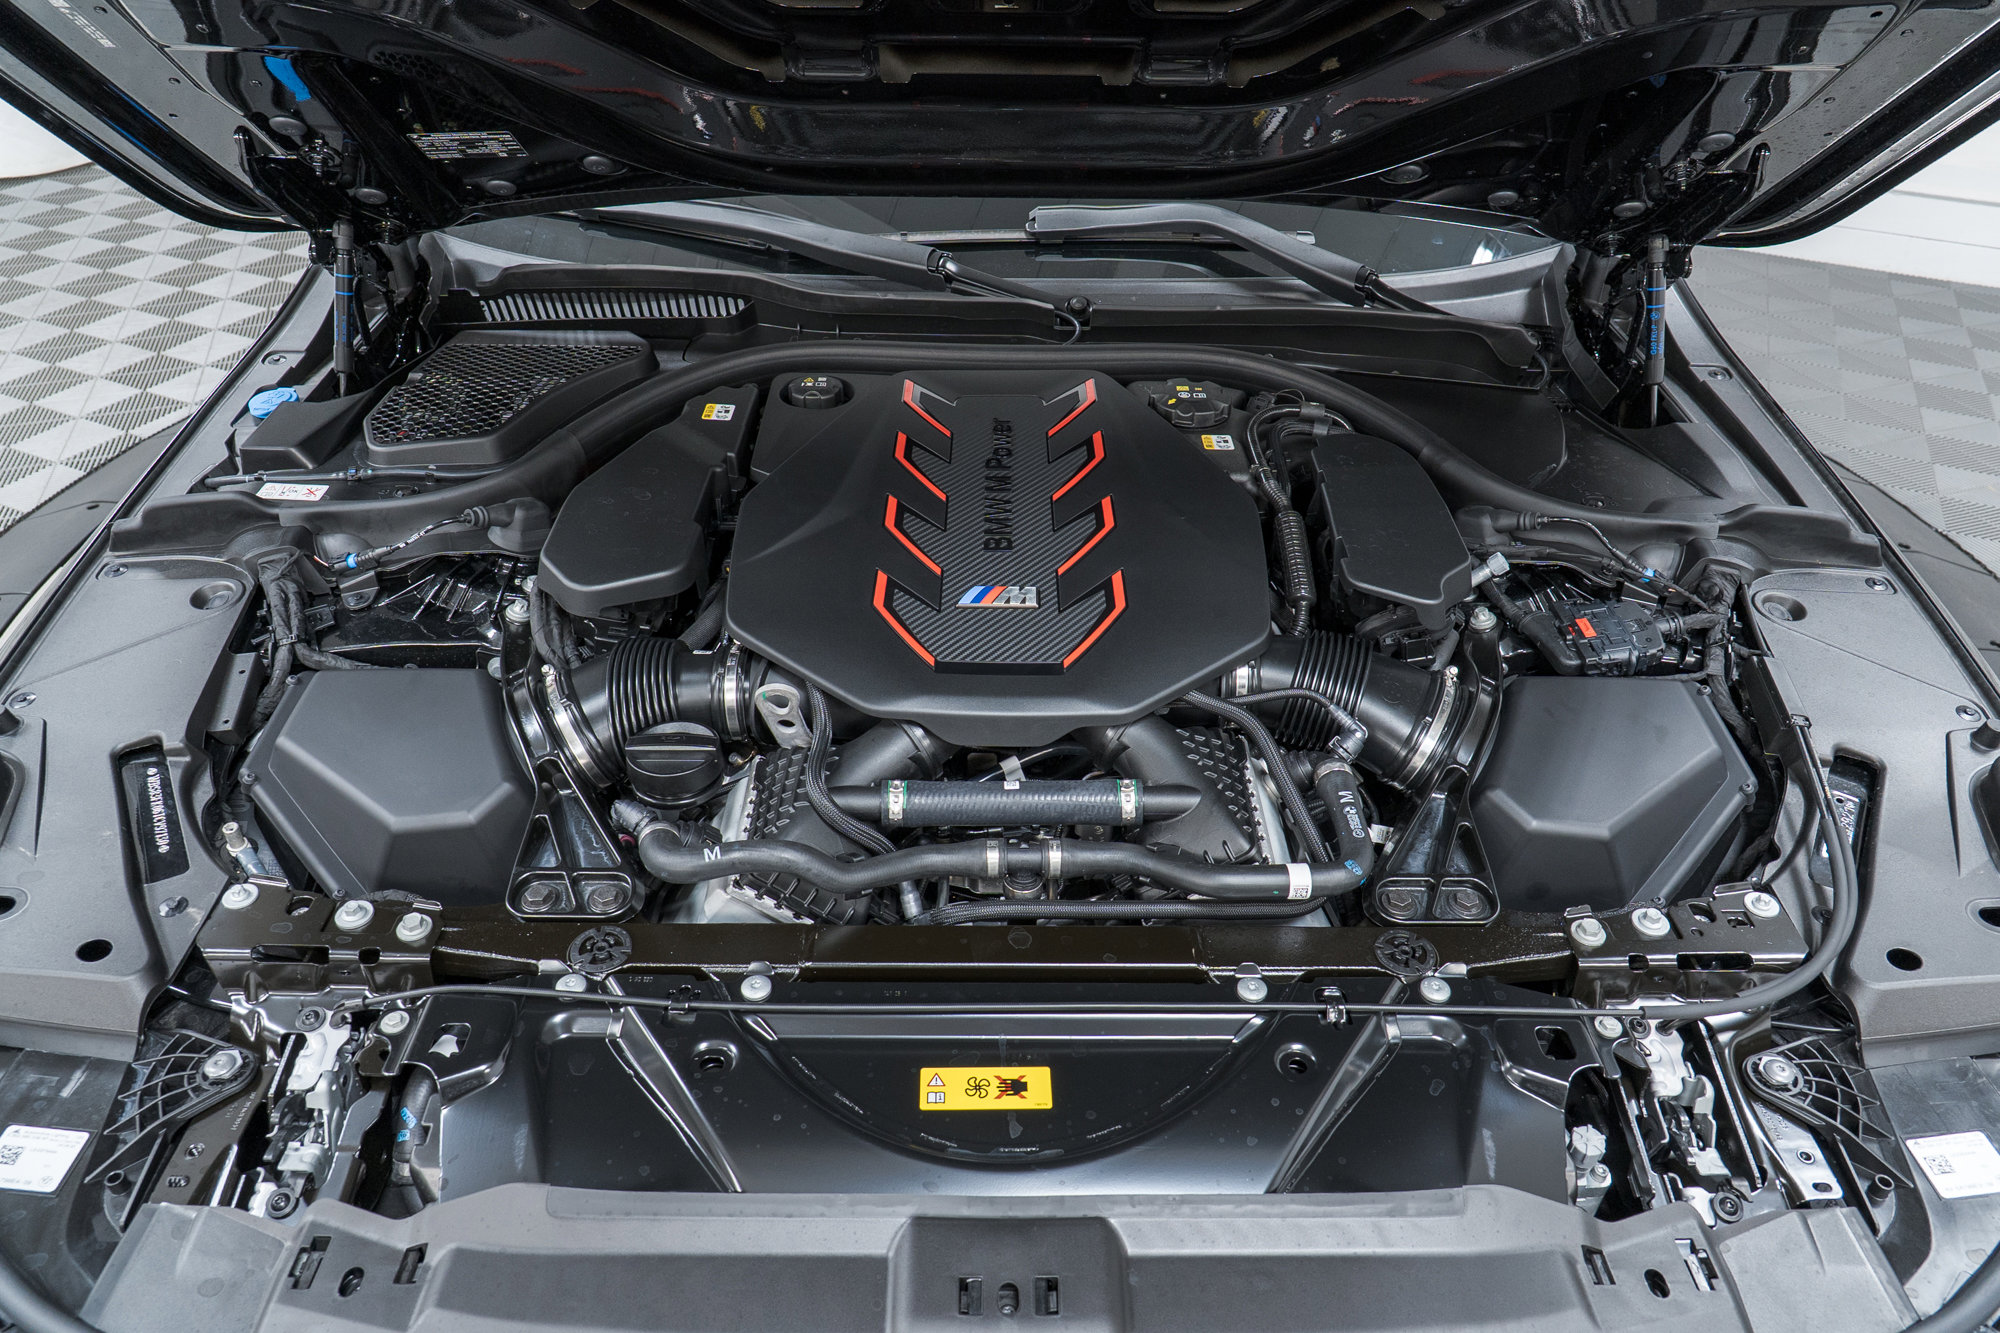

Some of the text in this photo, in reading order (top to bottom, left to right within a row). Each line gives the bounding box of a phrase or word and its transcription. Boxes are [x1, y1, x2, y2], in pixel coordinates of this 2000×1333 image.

[983, 418, 1013, 551] BMW M Power
[1338, 791, 1354, 803] M
[703, 846, 721, 862] M
